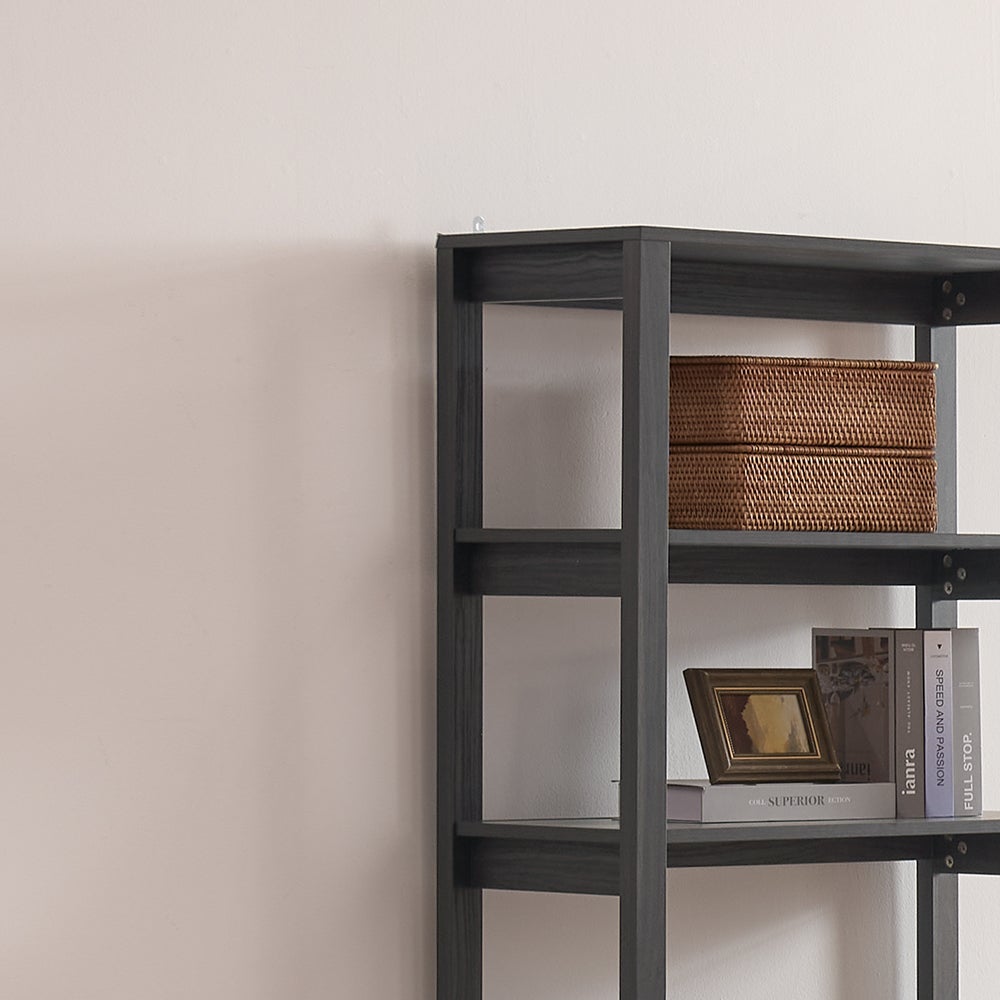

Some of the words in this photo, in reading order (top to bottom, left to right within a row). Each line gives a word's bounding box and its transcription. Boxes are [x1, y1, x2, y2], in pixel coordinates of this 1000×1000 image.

[935, 669, 944, 708] SPEED
[936, 709, 945, 734] AND
[901, 748, 916, 795] ianra
[936, 736, 945, 787] PASSION
[962, 732, 973, 772] STOP.
[768, 795, 825, 807] SUPERIOR
[963, 775, 974, 811] FULL
